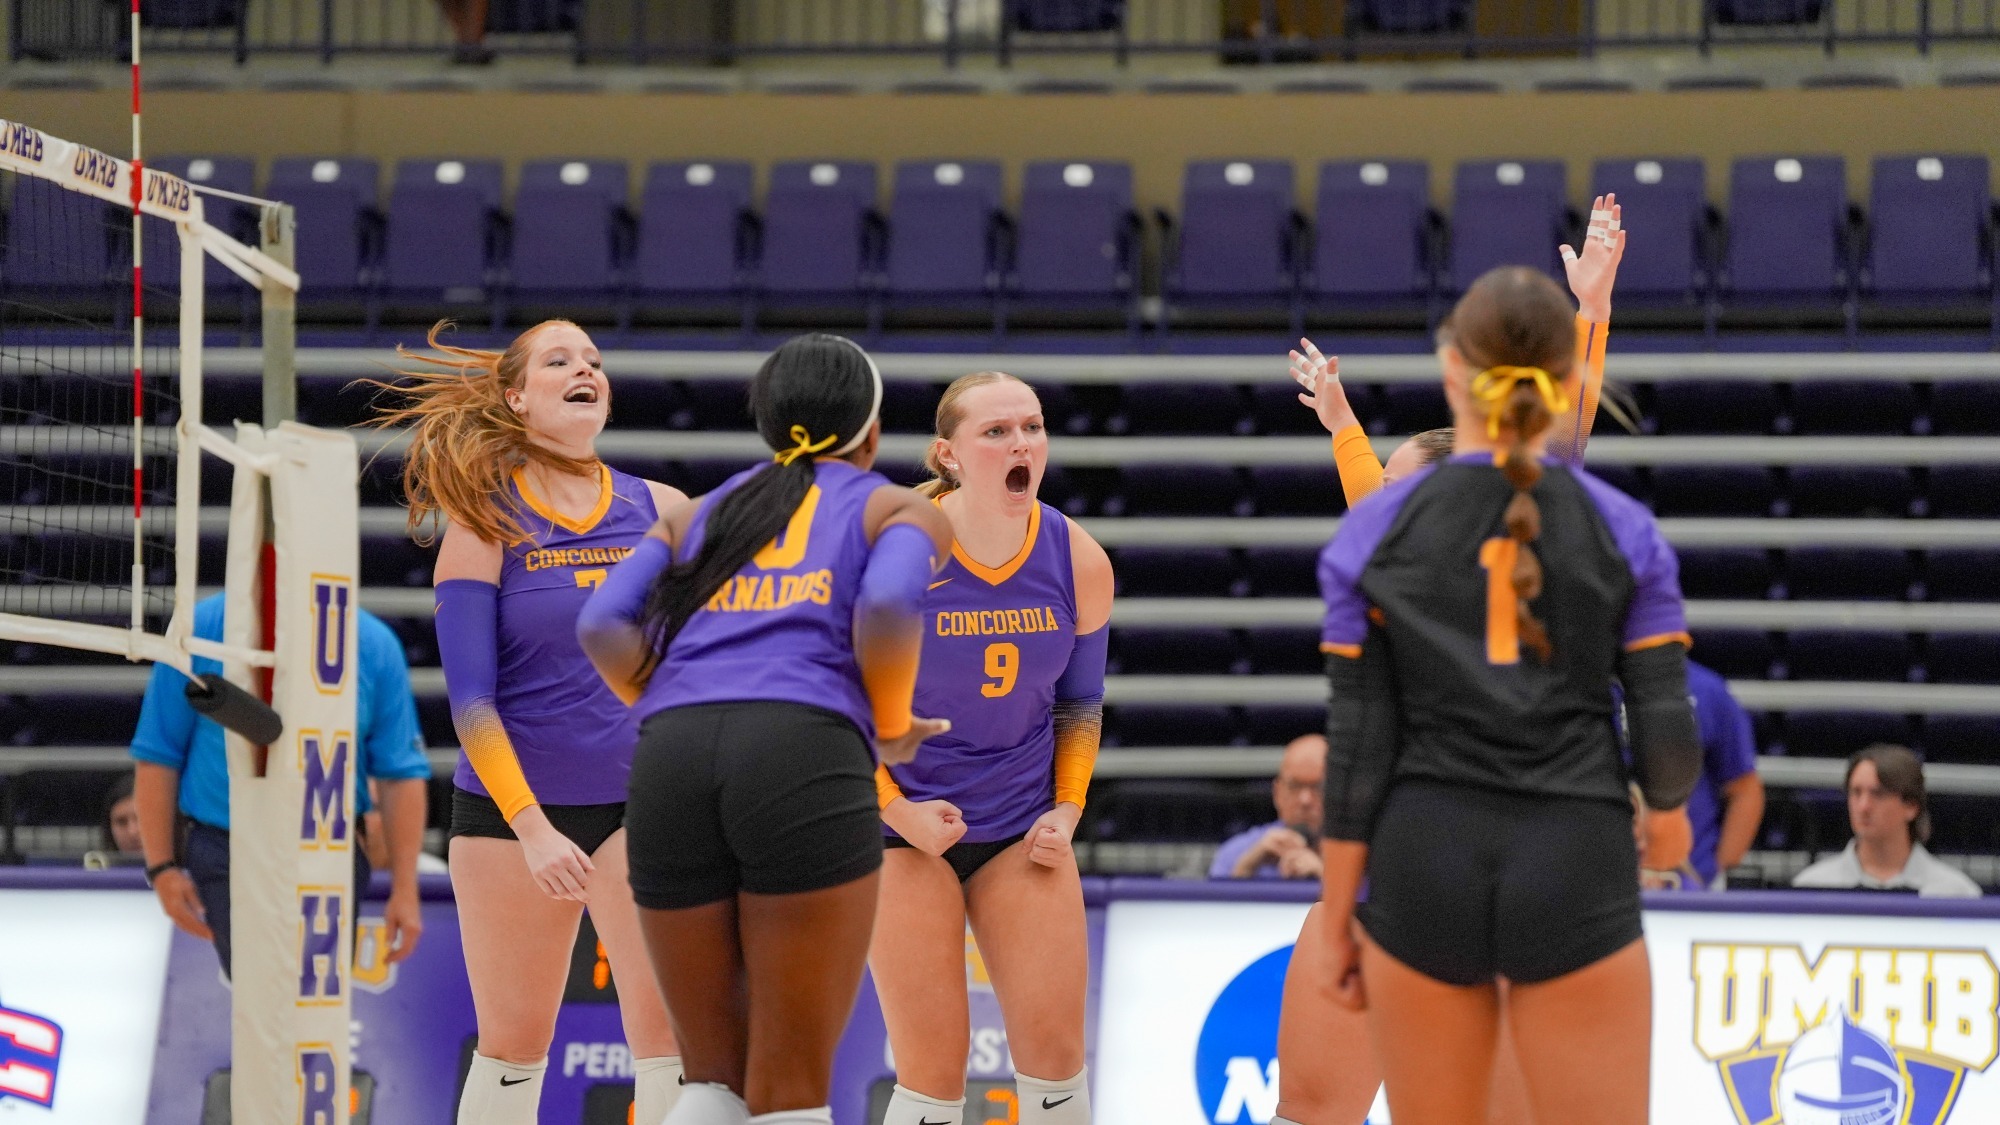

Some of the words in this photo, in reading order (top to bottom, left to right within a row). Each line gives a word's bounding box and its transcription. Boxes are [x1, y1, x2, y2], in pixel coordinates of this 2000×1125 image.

[74, 145, 118, 189] UMHB
[146, 173, 190, 212] UMHB
[704, 568, 833, 612] RNADOS
[1479, 537, 1520, 665] 1
[936, 606, 1059, 637] CONCORDIA
[980, 642, 1020, 698] 9
[1692, 941, 2000, 1073] UMHB
